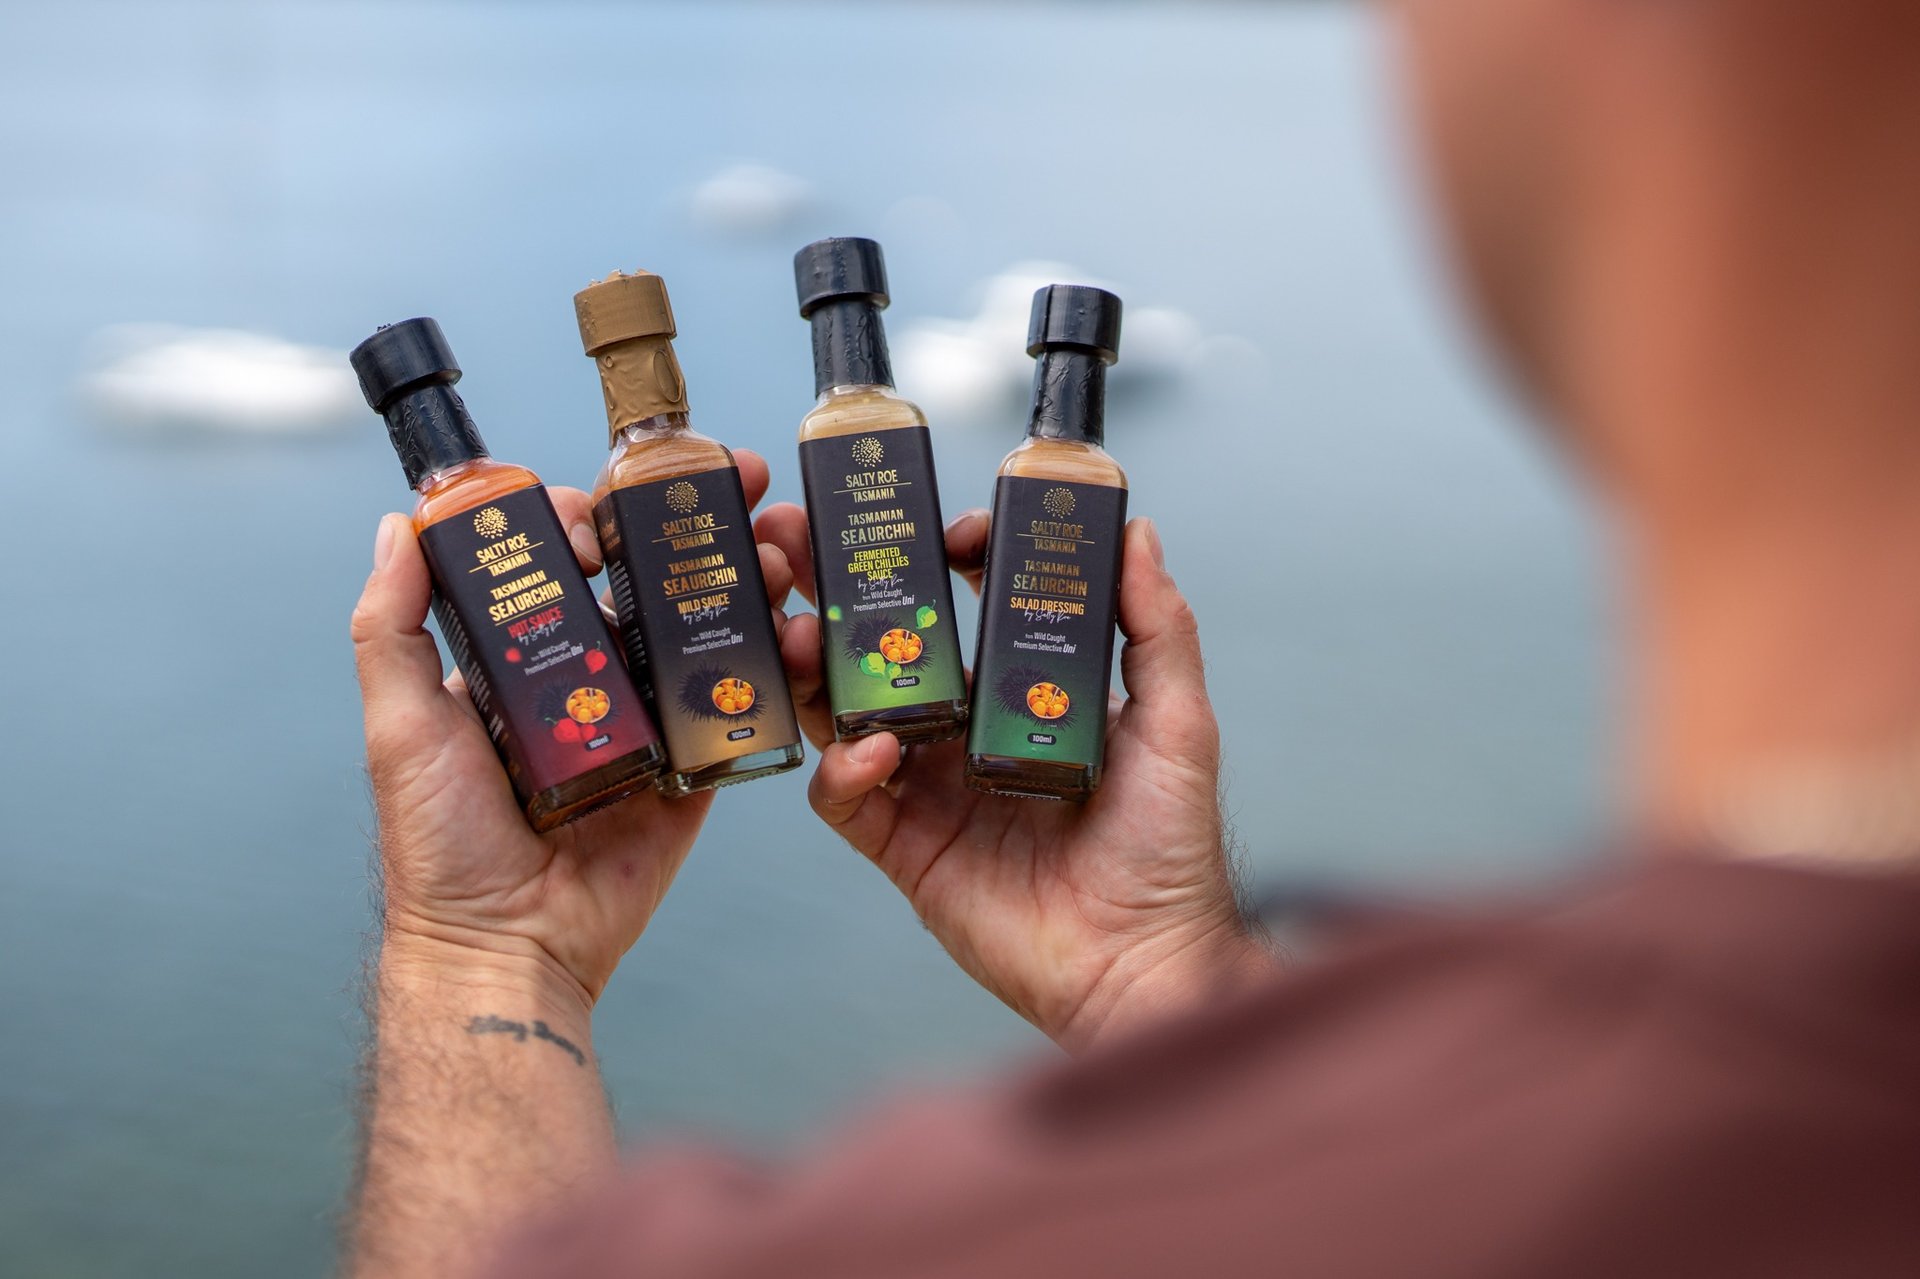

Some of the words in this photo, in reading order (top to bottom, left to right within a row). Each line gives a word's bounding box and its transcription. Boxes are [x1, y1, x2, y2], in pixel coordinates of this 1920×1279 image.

[845, 472, 875, 488] SALTY
[877, 469, 898, 484] ROE
[853, 487, 896, 503] TASMANIA
[662, 517, 692, 536] SALTY
[694, 513, 716, 529] ROE
[848, 508, 904, 526] TASMANIAN
[841, 527, 867, 546] SEA
[868, 522, 916, 541] URCHIN
[1030, 520, 1061, 536] SALTY
[1062, 522, 1084, 539] ROE
[476, 541, 508, 564] SALTY
[506, 532, 530, 552] ROE
[671, 532, 715, 551] TASMANIA
[1034, 538, 1077, 555] TASMANIA
[853, 546, 900, 562] FERMENTED
[488, 551, 533, 577] TASMANIA
[668, 553, 725, 575] TASMANIAN
[848, 560, 874, 573] GREEN
[874, 555, 910, 570] CHILLIES
[1024, 560, 1080, 577] TASMANIAN
[663, 575, 691, 596] SEA
[688, 566, 738, 589] URCHIN
[867, 569, 893, 581] SAUCE
[490, 570, 547, 601] TASMANIAN
[858, 579, 868, 593] by
[868, 577, 889, 591] Salty
[870, 590, 883, 600] Wild
[883, 588, 903, 599] Caught
[1013, 574, 1038, 591] SEA
[1039, 576, 1088, 596] URCHIN
[488, 598, 521, 622] SEA
[514, 581, 564, 611] URCHIN
[677, 599, 701, 615] MILD
[701, 592, 730, 610] SAUCE
[852, 603, 878, 613] Premium
[877, 599, 902, 610] Selective
[902, 594, 915, 606] Uni
[1010, 596, 1039, 610] SALAD
[1041, 600, 1085, 615] DRESSING
[507, 616, 530, 639] HOT
[528, 606, 565, 631] SAUCE
[683, 613, 693, 625] by
[1024, 608, 1033, 622] by
[1035, 608, 1056, 624] Salty
[518, 632, 530, 646] by
[699, 630, 712, 641] Wild
[711, 627, 731, 638] Caught
[1034, 632, 1046, 641] Wild
[1046, 633, 1066, 643] Caught
[538, 645, 552, 658] Wild
[549, 640, 570, 654] Caught
[682, 643, 708, 655] Premium
[707, 638, 731, 650] Selective
[730, 632, 744, 644] Uni
[1013, 640, 1038, 650] Premium
[1038, 643, 1062, 653] Selective
[1062, 643, 1076, 654] Uni
[524, 661, 549, 676] Premium
[547, 651, 573, 667] Selective
[570, 642, 585, 657] Uni
[895, 677, 916, 687] 100ml
[588, 735, 610, 749] 100ml
[731, 729, 751, 740] 100ml
[1032, 734, 1052, 744] 100ml
